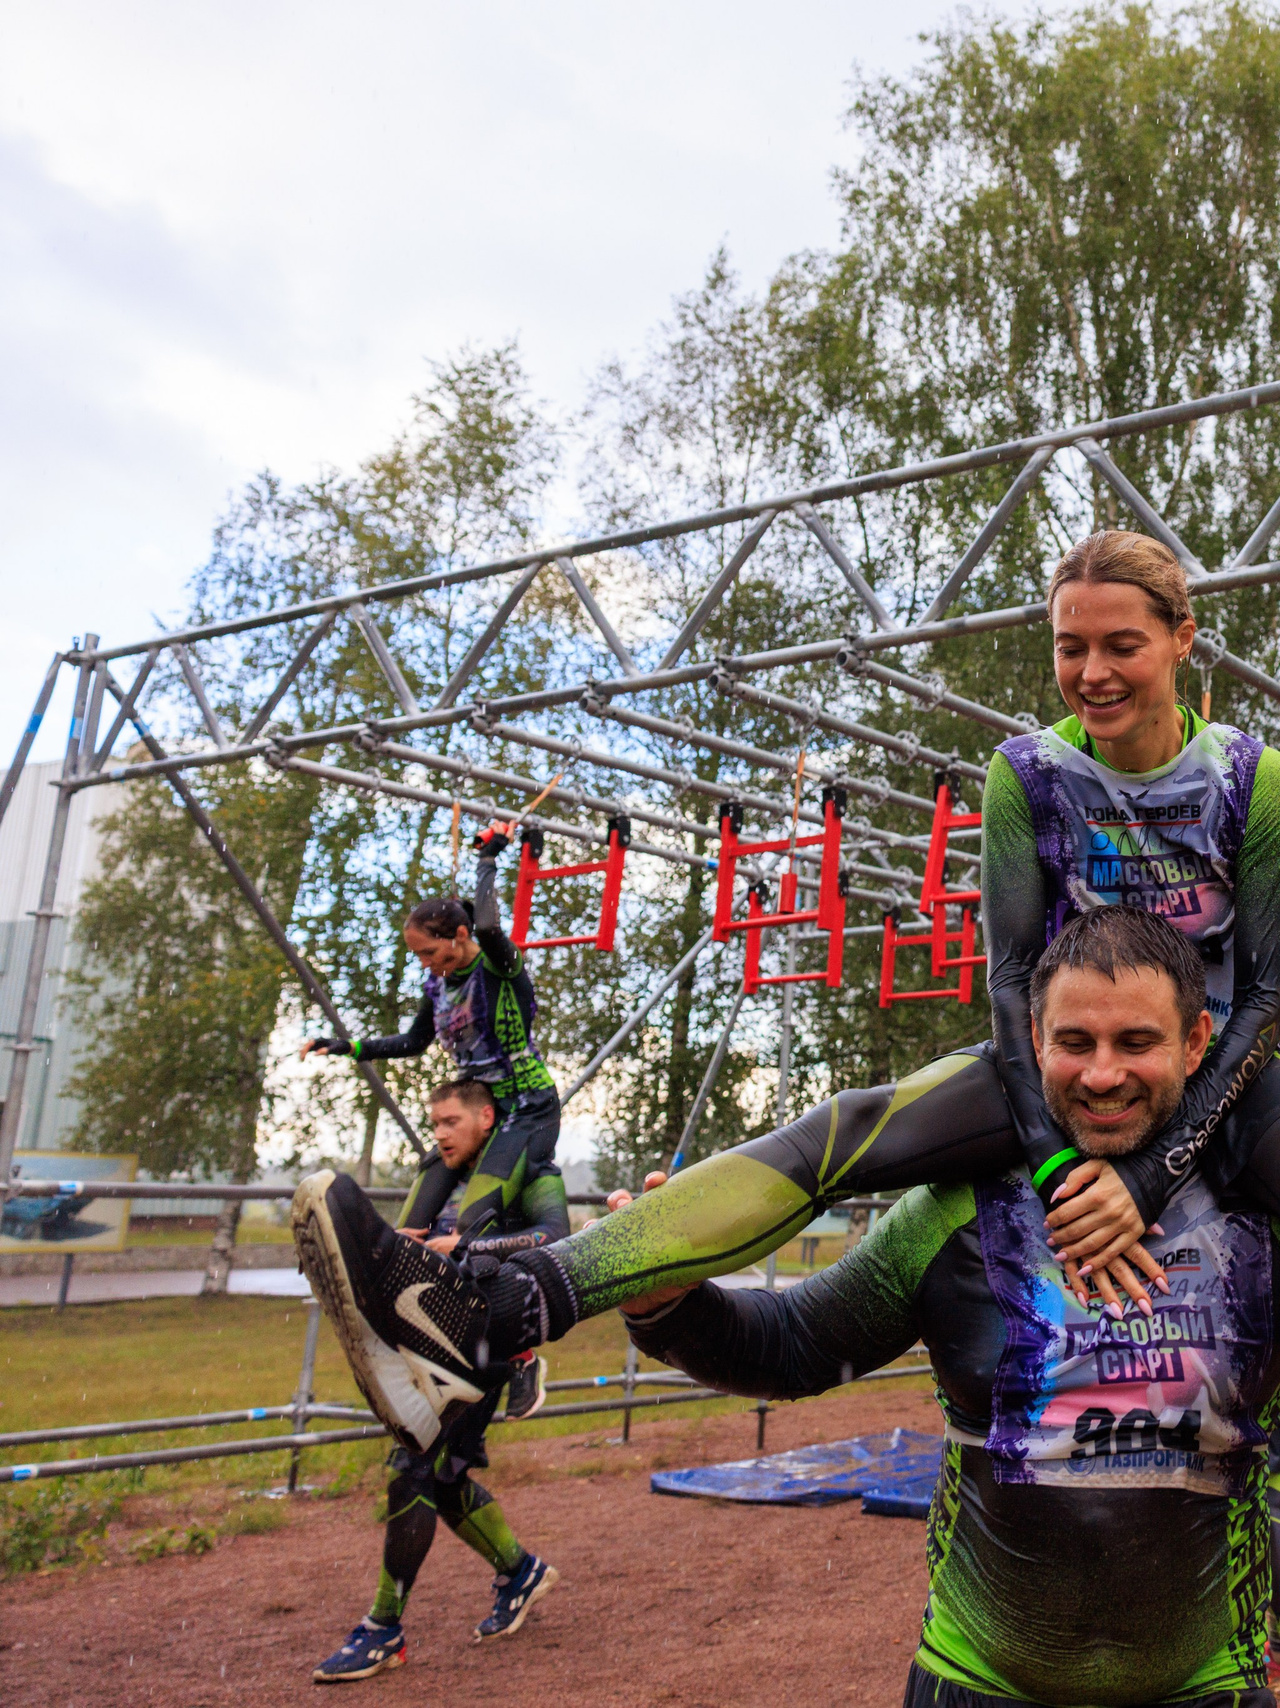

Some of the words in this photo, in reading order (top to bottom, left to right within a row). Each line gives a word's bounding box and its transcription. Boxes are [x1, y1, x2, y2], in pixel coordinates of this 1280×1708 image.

[1134, 804, 1202, 821] ГЕРОЕВ
[1165, 1038, 1265, 1176] Greenway
[469, 1234, 536, 1251] reenway
[1101, 1347, 1176, 1380] СТАРТ
